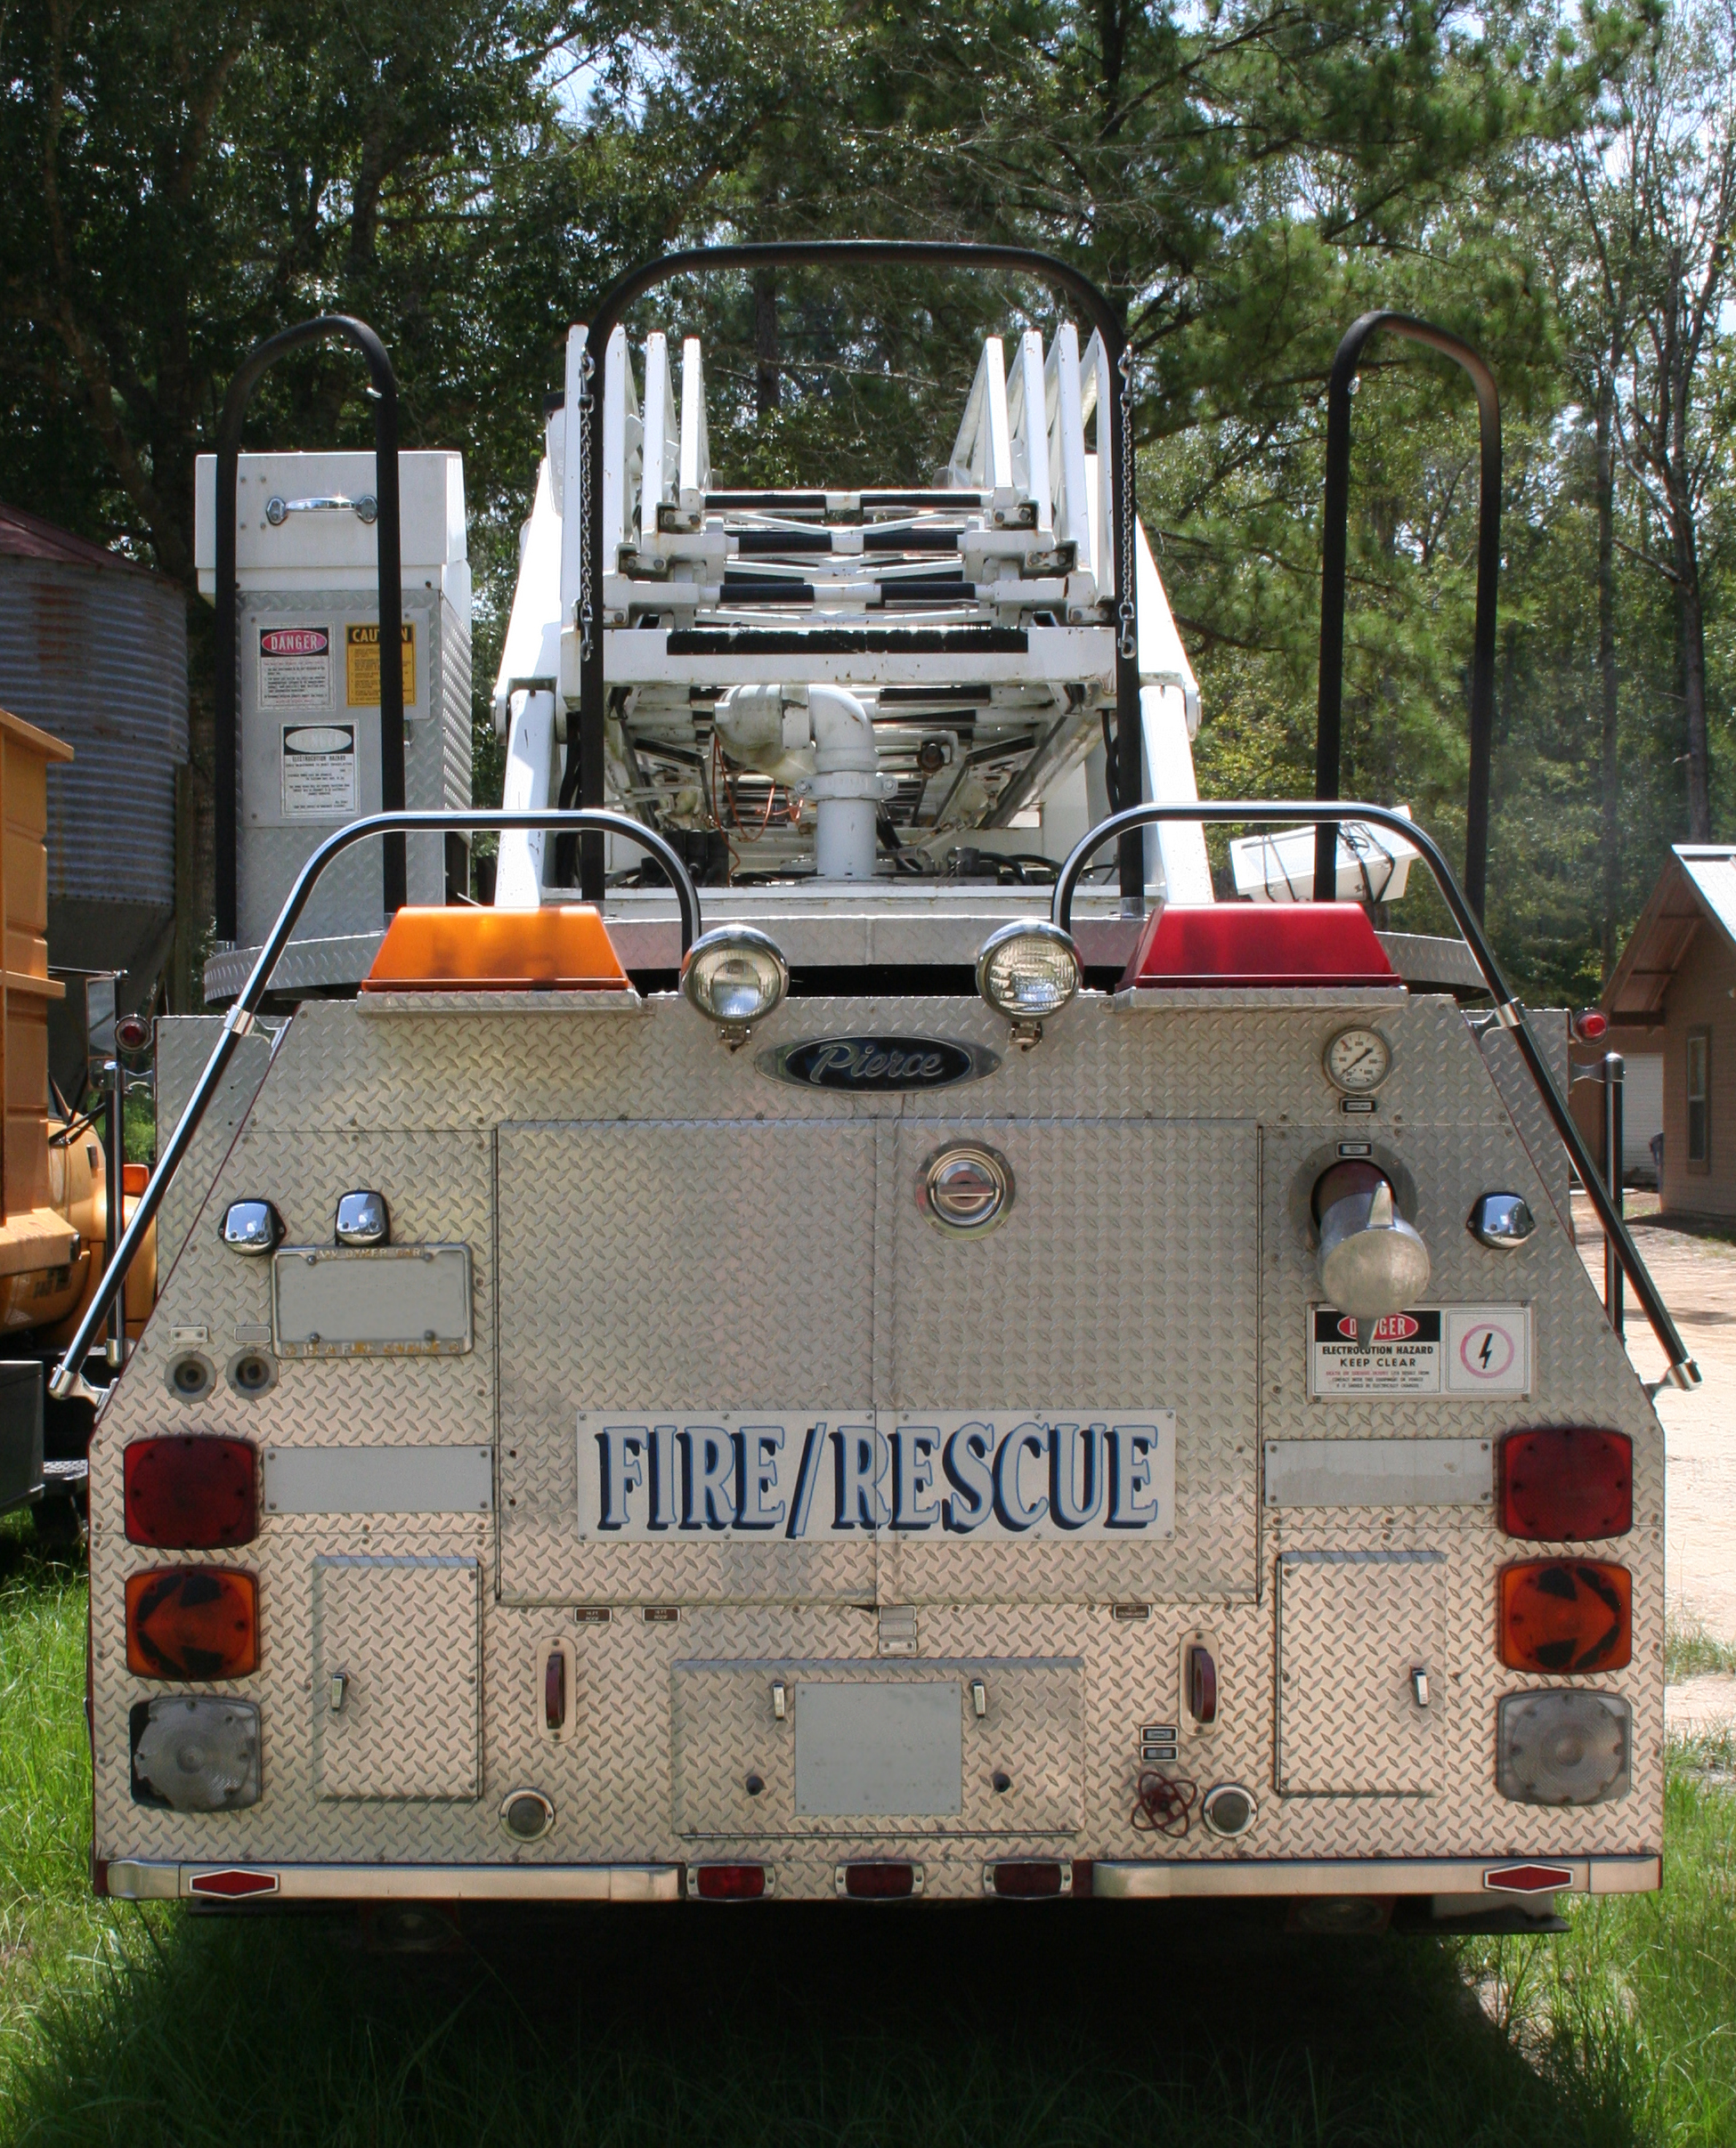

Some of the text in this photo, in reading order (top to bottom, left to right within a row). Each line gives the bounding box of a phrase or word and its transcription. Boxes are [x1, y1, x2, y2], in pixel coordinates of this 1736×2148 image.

[271, 635, 318, 651] DANGER
[352, 628, 409, 643] CAUN
[809, 1042, 945, 1084] Pierce
[345, 1248, 387, 1258] OTHER
[395, 1247, 421, 1258] CAR
[1349, 1317, 1407, 1336] DGER
[341, 1342, 374, 1355] FIRE
[384, 1341, 442, 1354] ENGINE
[1322, 1345, 1433, 1355] ELECTROCUTION HAZARD
[1340, 1358, 1416, 1367] KEEP CLEAR
[595, 1422, 1157, 1539] FIRE/RESCUE
